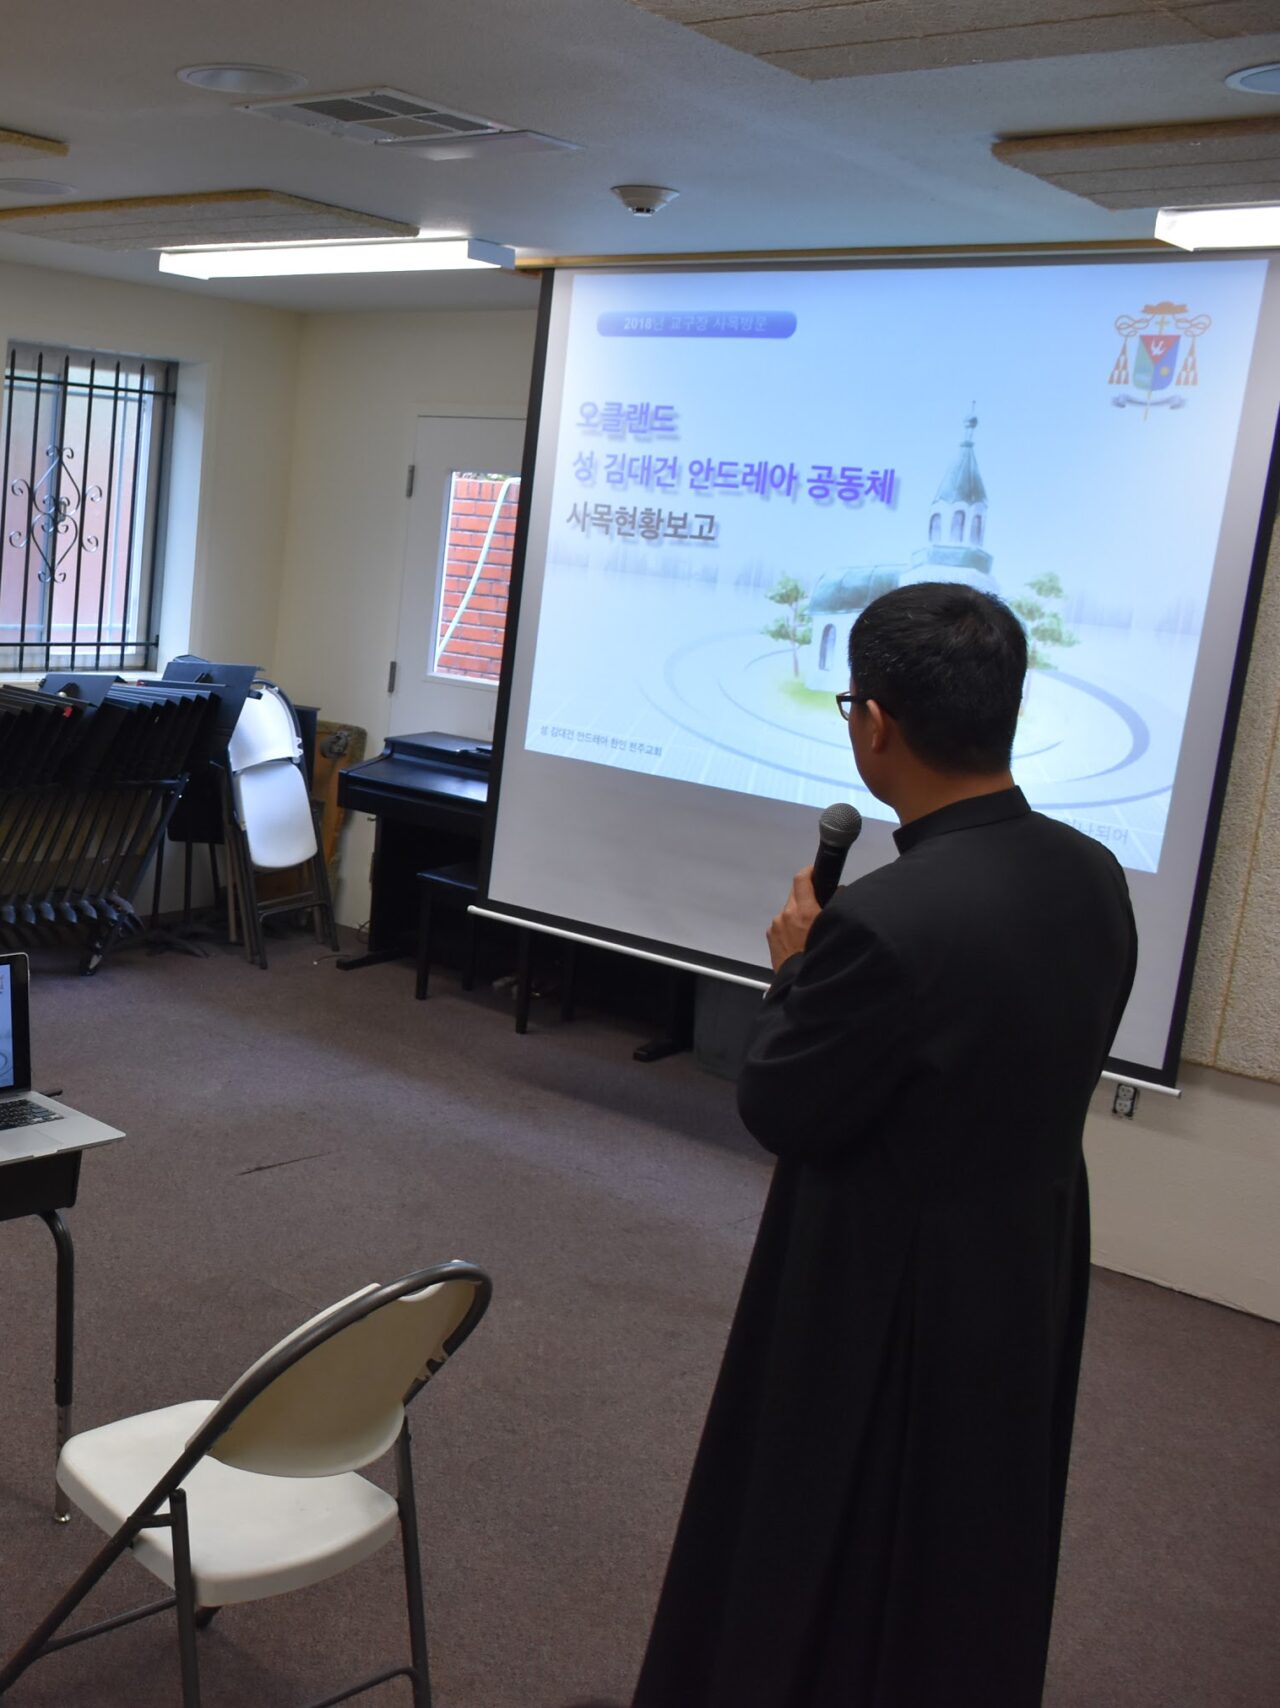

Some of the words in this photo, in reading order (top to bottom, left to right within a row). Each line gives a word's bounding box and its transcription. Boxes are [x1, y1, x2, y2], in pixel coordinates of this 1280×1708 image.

[623, 316, 664, 332] 2018년
[576, 401, 677, 435] 오클랜드
[572, 450, 594, 483] 성
[603, 452, 679, 488] 김대건
[688, 457, 797, 497] 안드레아
[806, 465, 896, 506] 공동체
[566, 500, 716, 542] 사목현황보고
